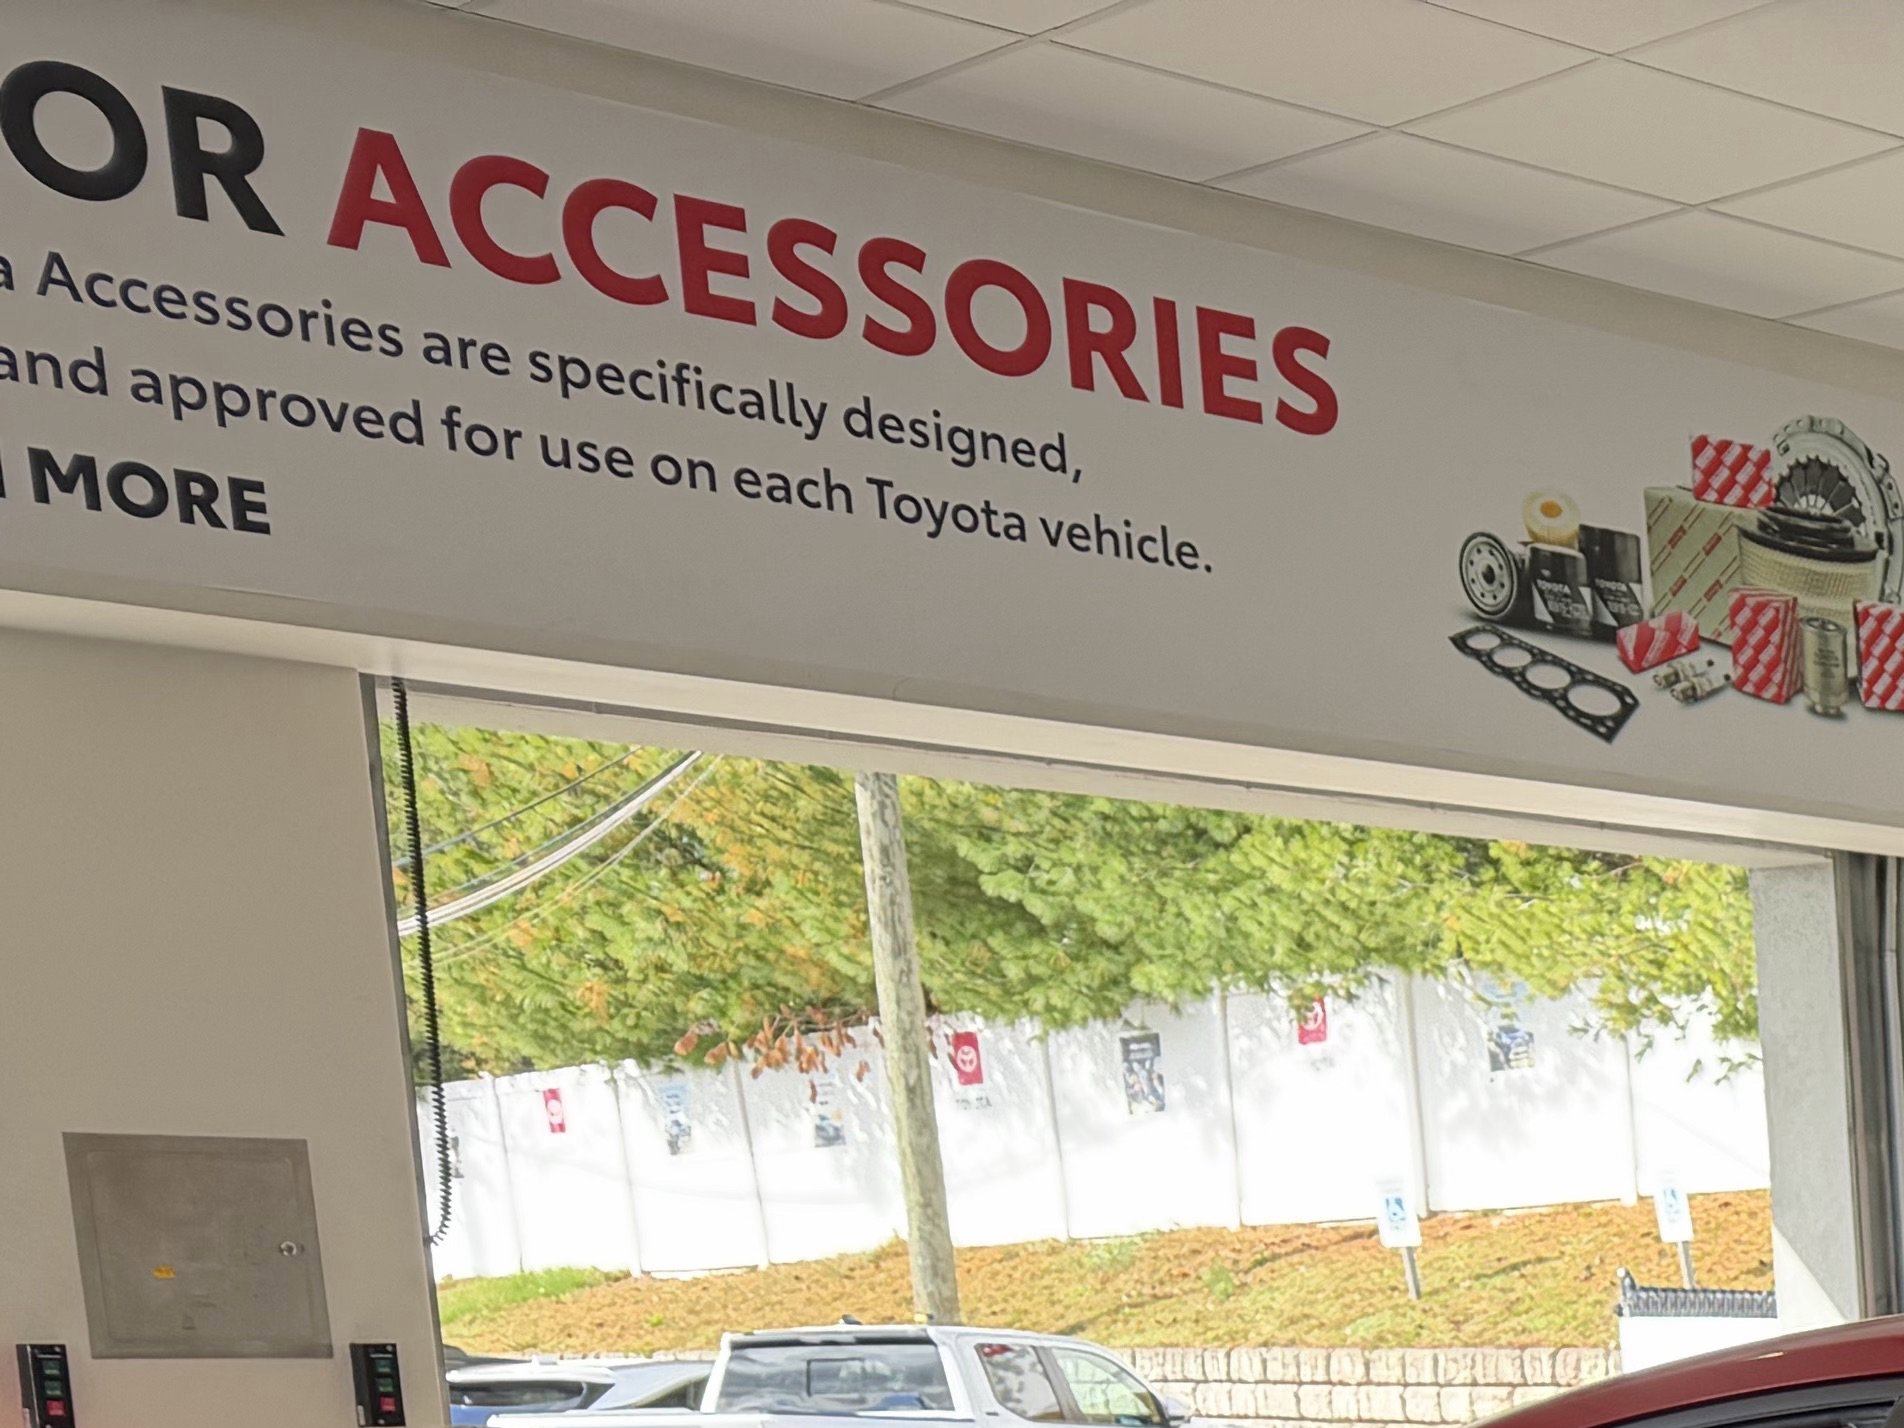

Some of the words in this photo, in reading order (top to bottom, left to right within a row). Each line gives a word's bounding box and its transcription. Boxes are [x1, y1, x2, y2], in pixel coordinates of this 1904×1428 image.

[0, 60, 285, 237] OR
[326, 127, 1339, 436] ACCESSORIES
[0, 345, 109, 396] and
[130, 368, 425, 446] approved
[441, 405, 521, 459] for
[540, 436, 634, 479] use
[650, 454, 717, 491] on
[733, 467, 853, 513] each
[866, 477, 1027, 542] Toyota
[1040, 515, 1214, 571] vehicle.
[37, 252, 403, 358] Accessories
[423, 332, 510, 376] are
[529, 350, 828, 441] specifically
[842, 397, 1083, 484] designed,
[28, 447, 271, 536] MORE
